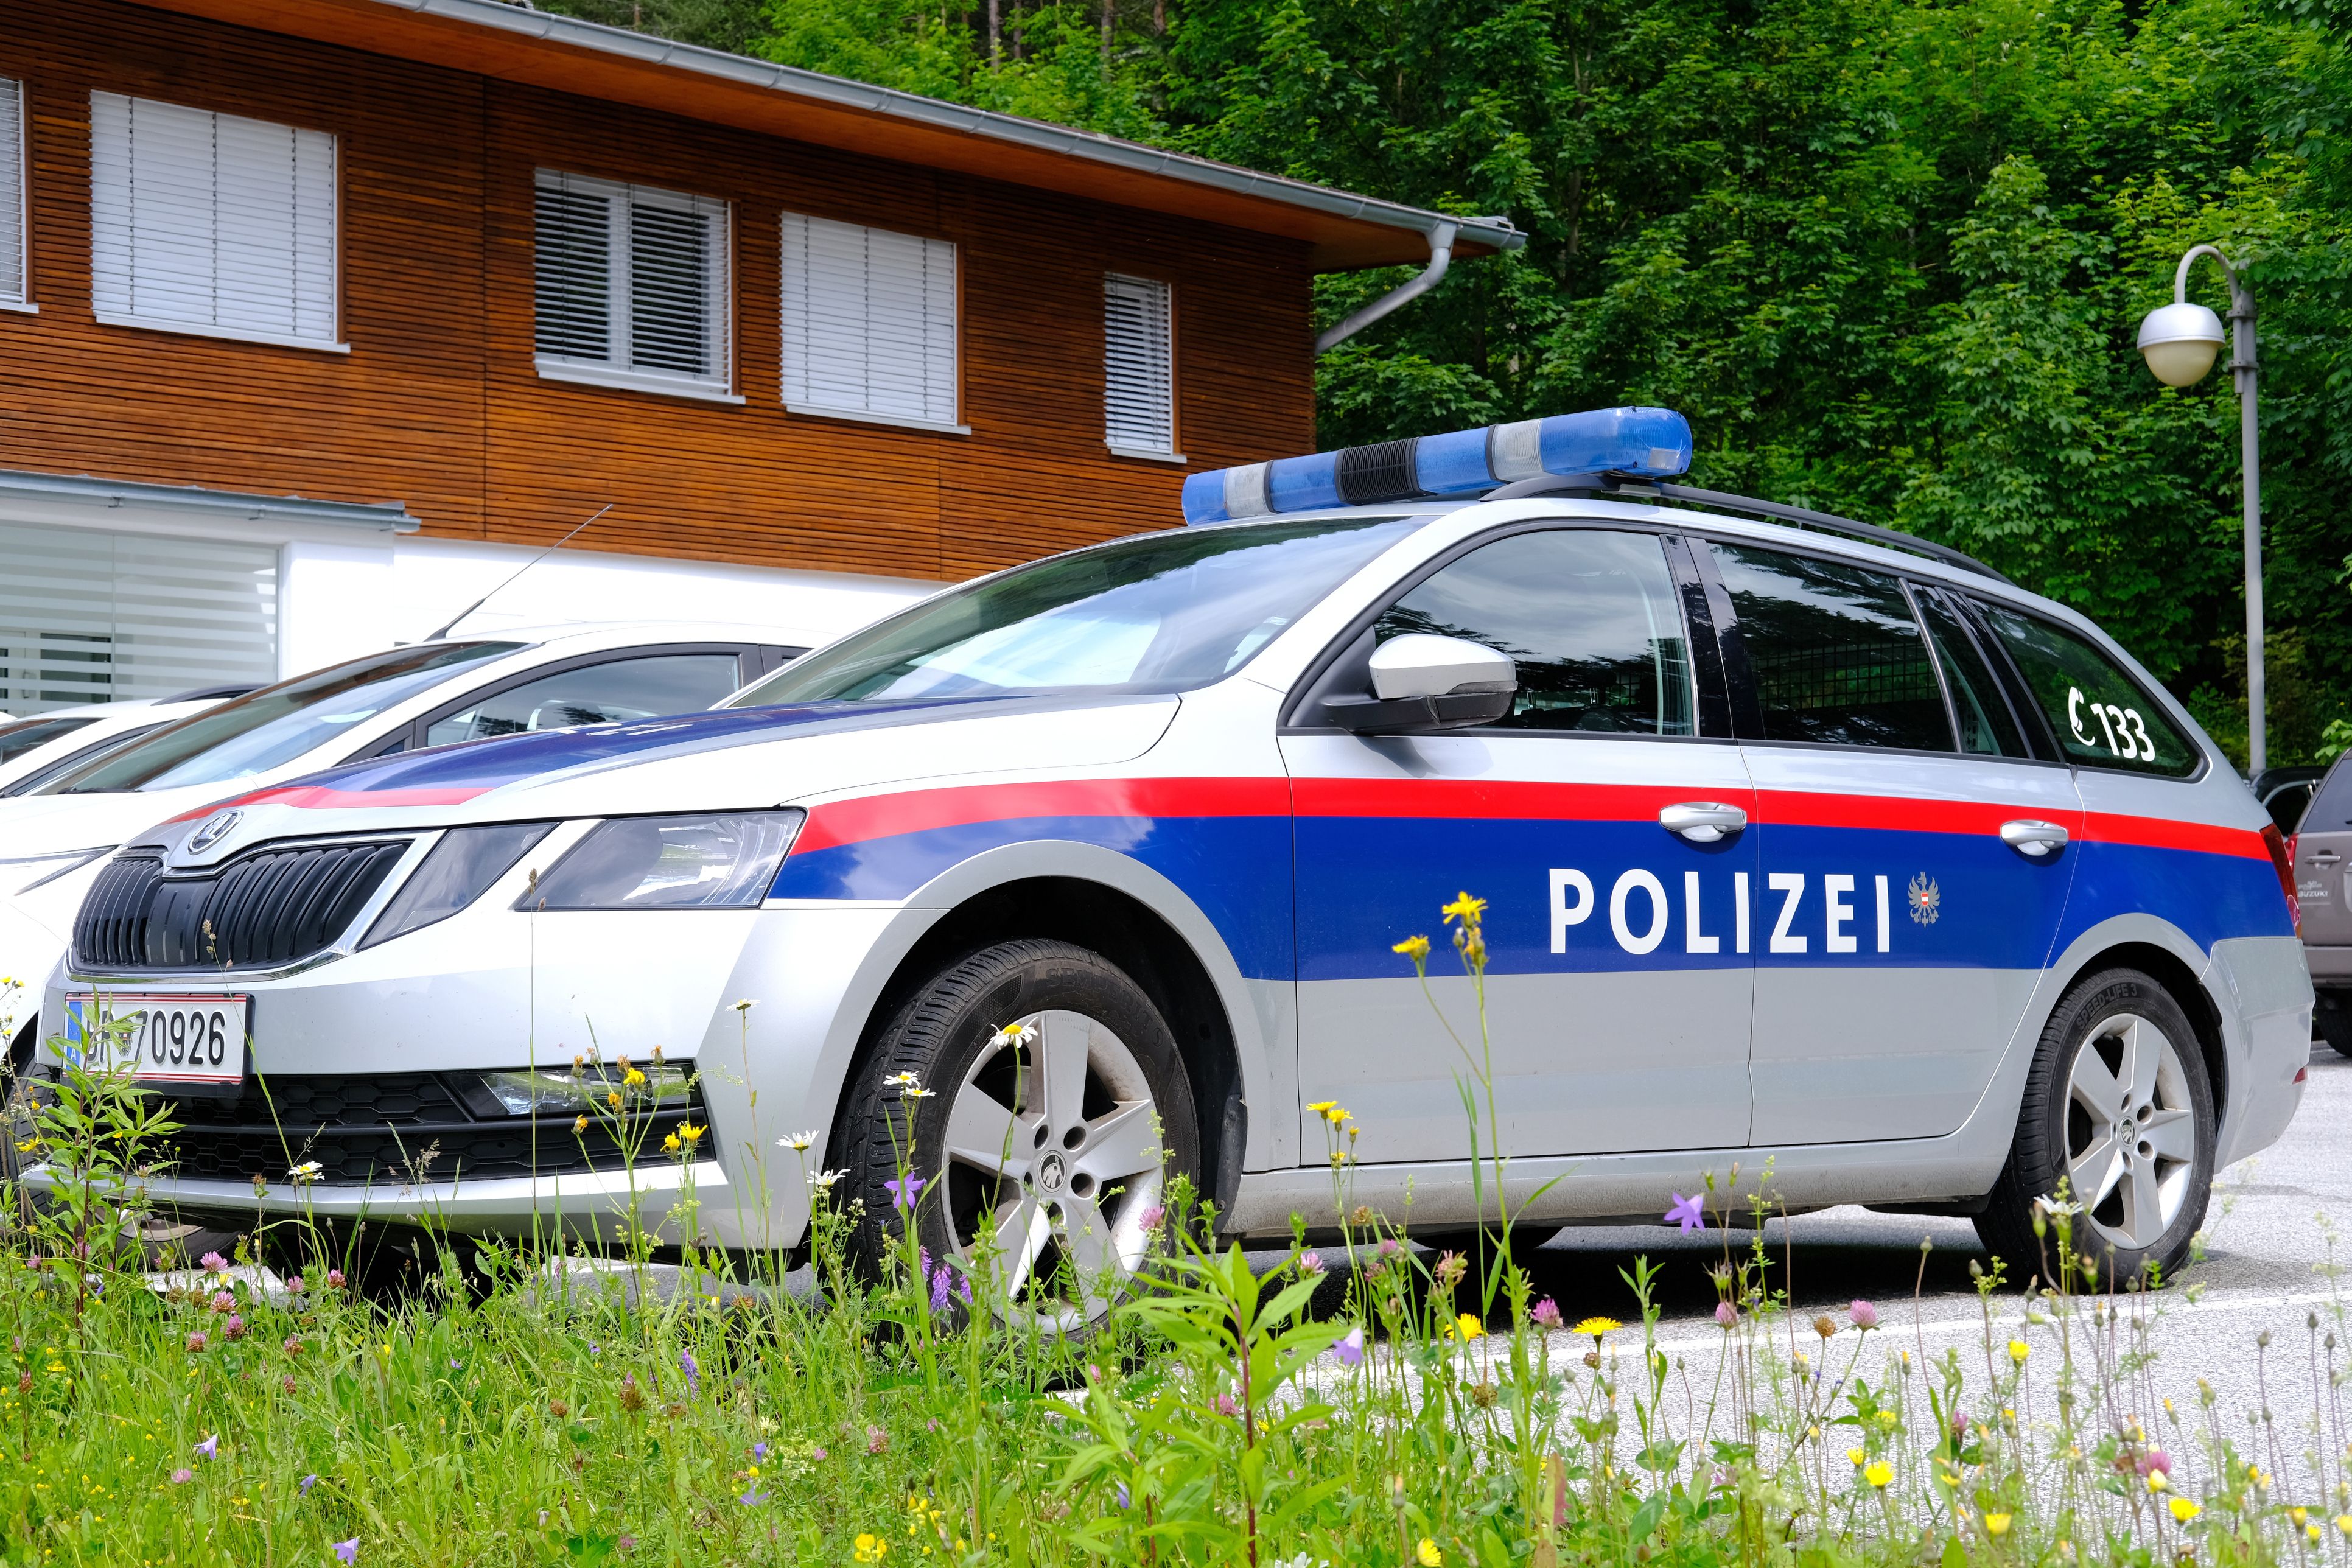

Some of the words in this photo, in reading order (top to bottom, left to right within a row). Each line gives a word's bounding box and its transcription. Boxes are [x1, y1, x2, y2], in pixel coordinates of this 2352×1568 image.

[2090, 703, 2155, 761] 133
[1549, 869, 1890, 955] POLIZEI
[1045, 968, 1153, 1031] SEMPERIT
[2076, 983, 2129, 1030] SPEED-LIFE
[2130, 984, 2138, 996] 3
[70, 1048, 77, 1061] A
[133, 1010, 226, 1066] 70926
